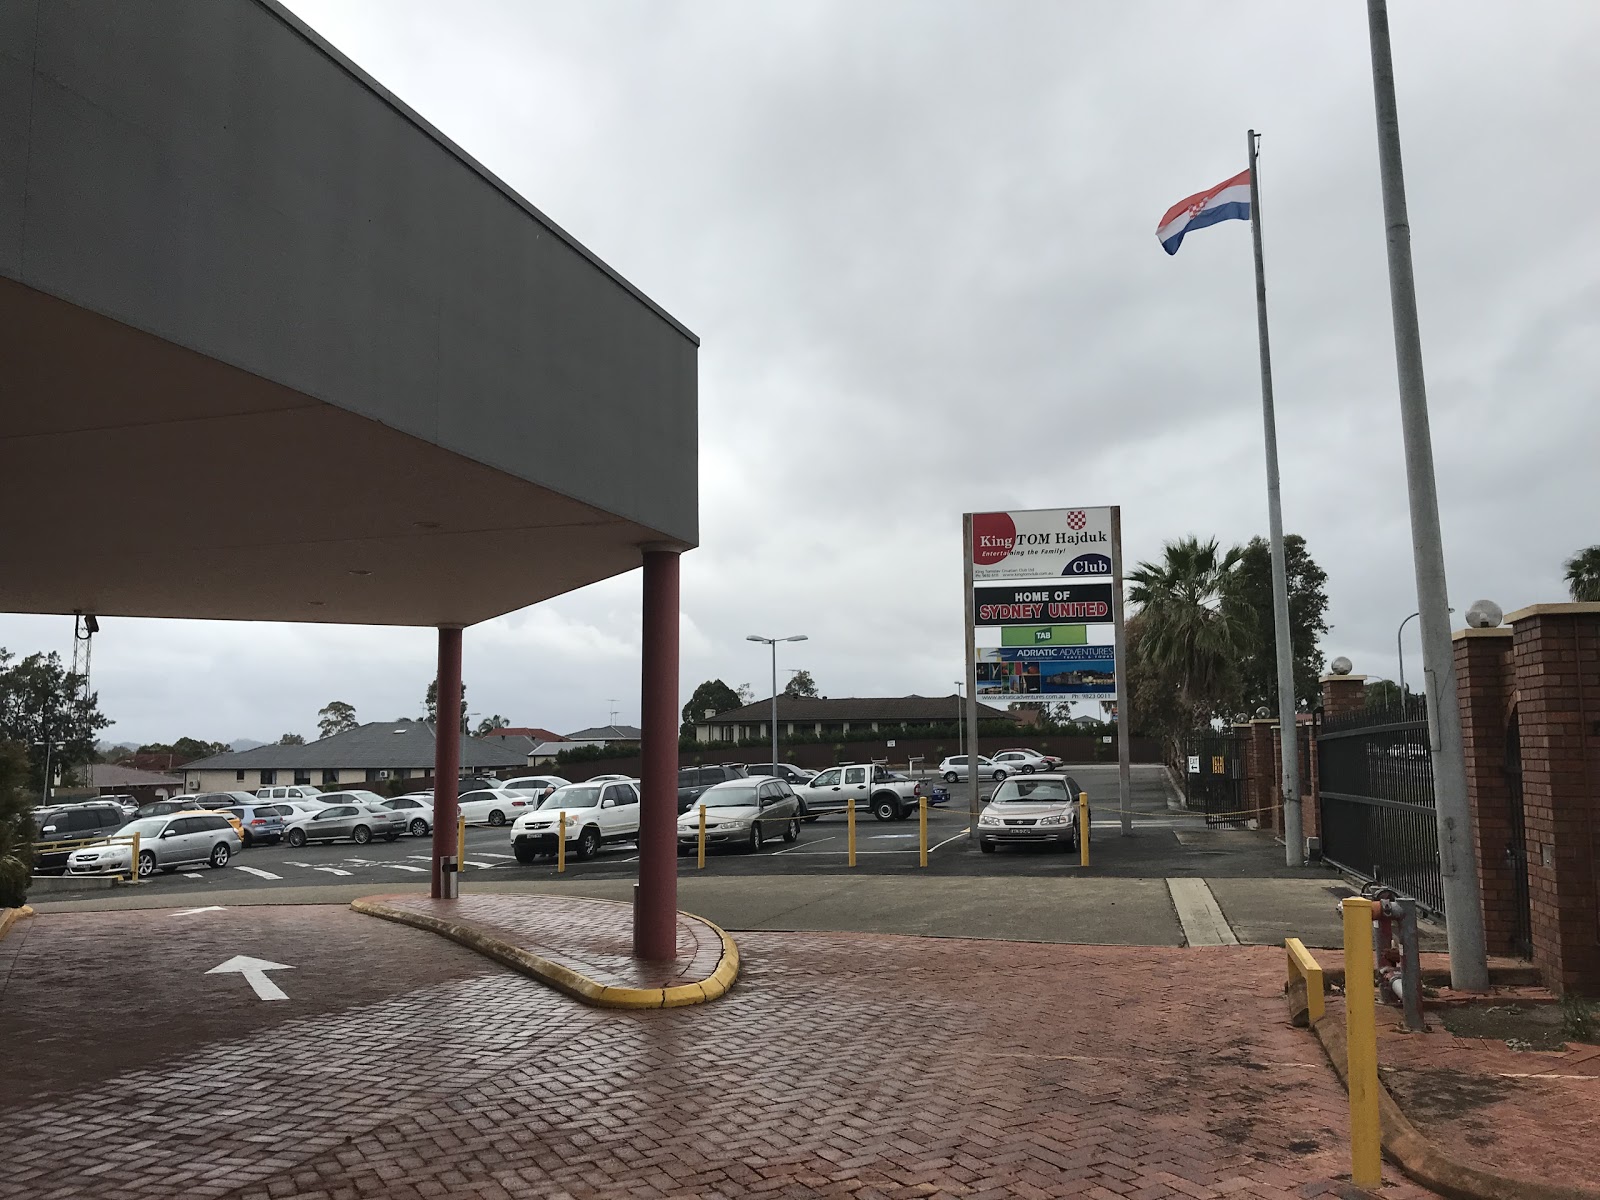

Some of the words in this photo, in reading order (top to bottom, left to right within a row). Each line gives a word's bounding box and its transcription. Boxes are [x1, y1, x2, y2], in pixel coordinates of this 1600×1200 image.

[980, 535, 1013, 549] King
[1016, 533, 1052, 546] TOM
[1055, 530, 1107, 546] Hajduk
[981, 548, 1025, 557] Entertaining
[1041, 547, 1067, 556] Family!
[1072, 560, 1108, 573] Club
[1015, 592, 1049, 602] HOME
[1054, 591, 1071, 601] OF
[979, 603, 1043, 619] SYDNEY
[1049, 601, 1108, 617] UNITED
[1036, 631, 1051, 640] TAB
[1016, 648, 1058, 657] ADRIATIC
[1060, 647, 1113, 656] ADVENTURES
